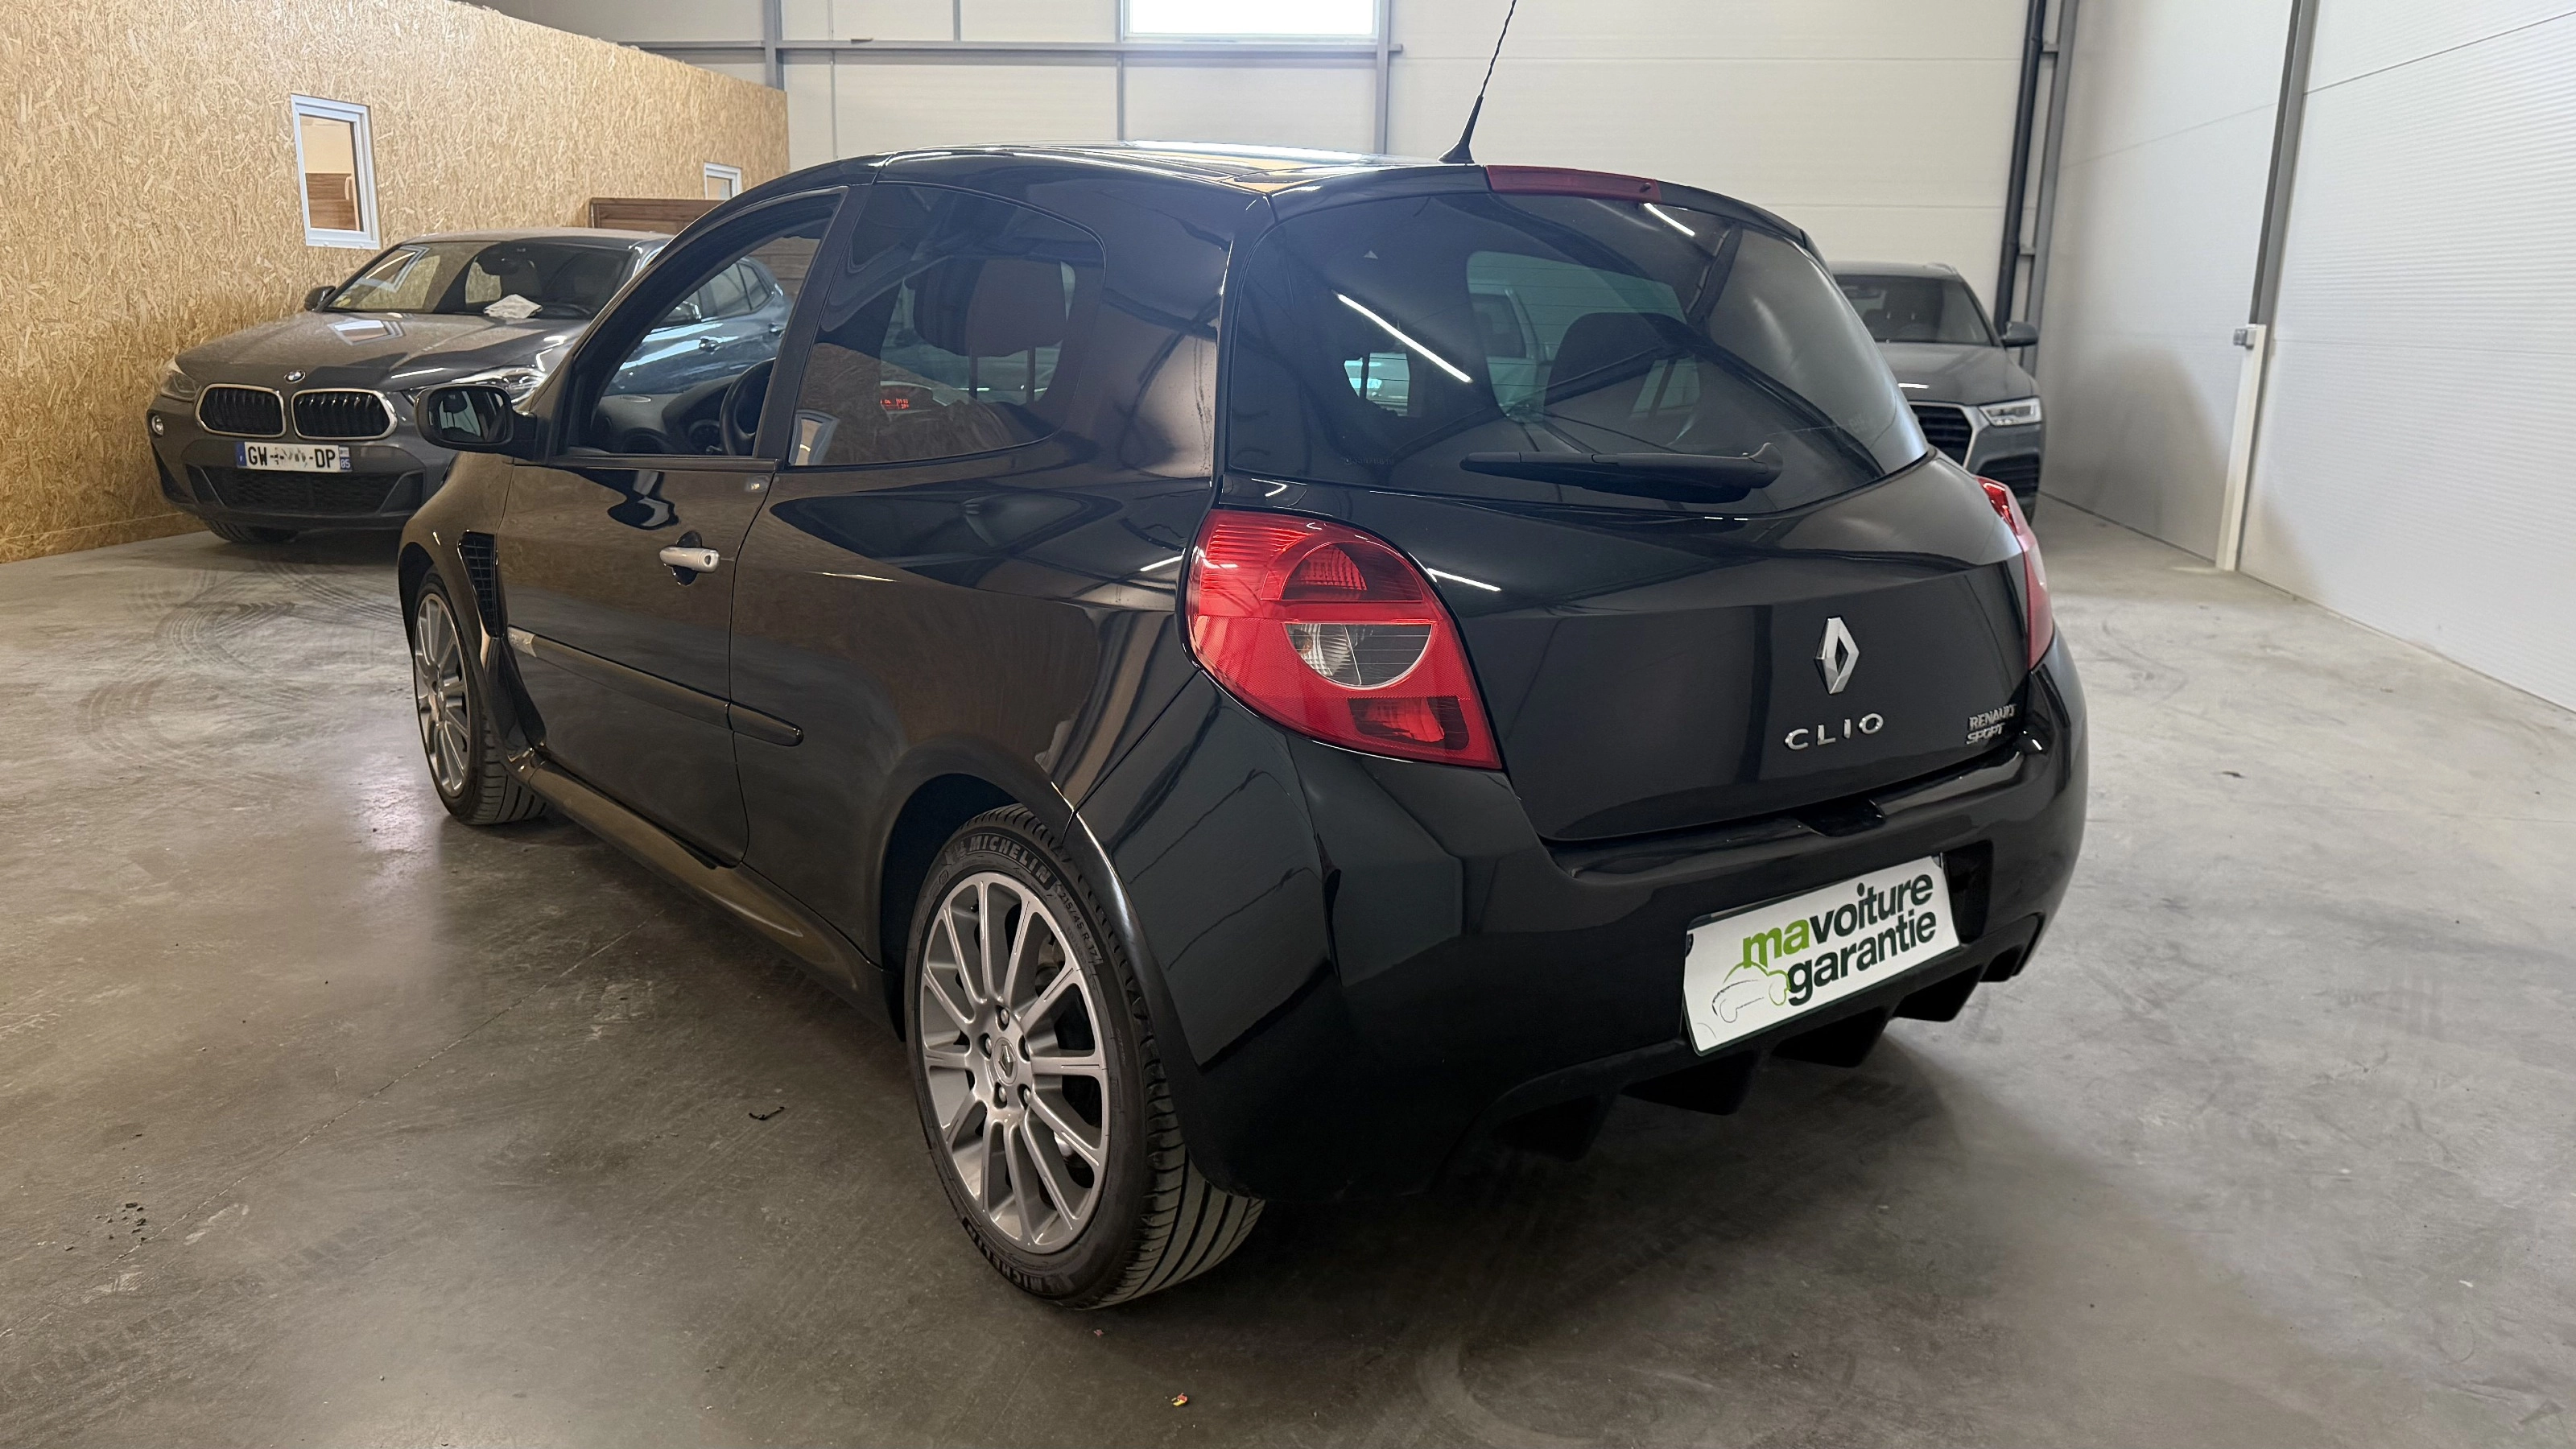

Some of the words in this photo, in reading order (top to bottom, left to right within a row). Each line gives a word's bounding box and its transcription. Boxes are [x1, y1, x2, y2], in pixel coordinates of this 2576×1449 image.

[1785, 712, 1884, 750] CLIO
[1966, 722, 2006, 745] SPORT
[1968, 704, 2017, 731] RENAULT
[969, 835, 1052, 885] MICHELIN
[1059, 893, 1085, 929] 215/45
[1082, 932, 1090, 941] R
[1088, 944, 1098, 956] 17
[1788, 910, 1937, 1006] garantie
